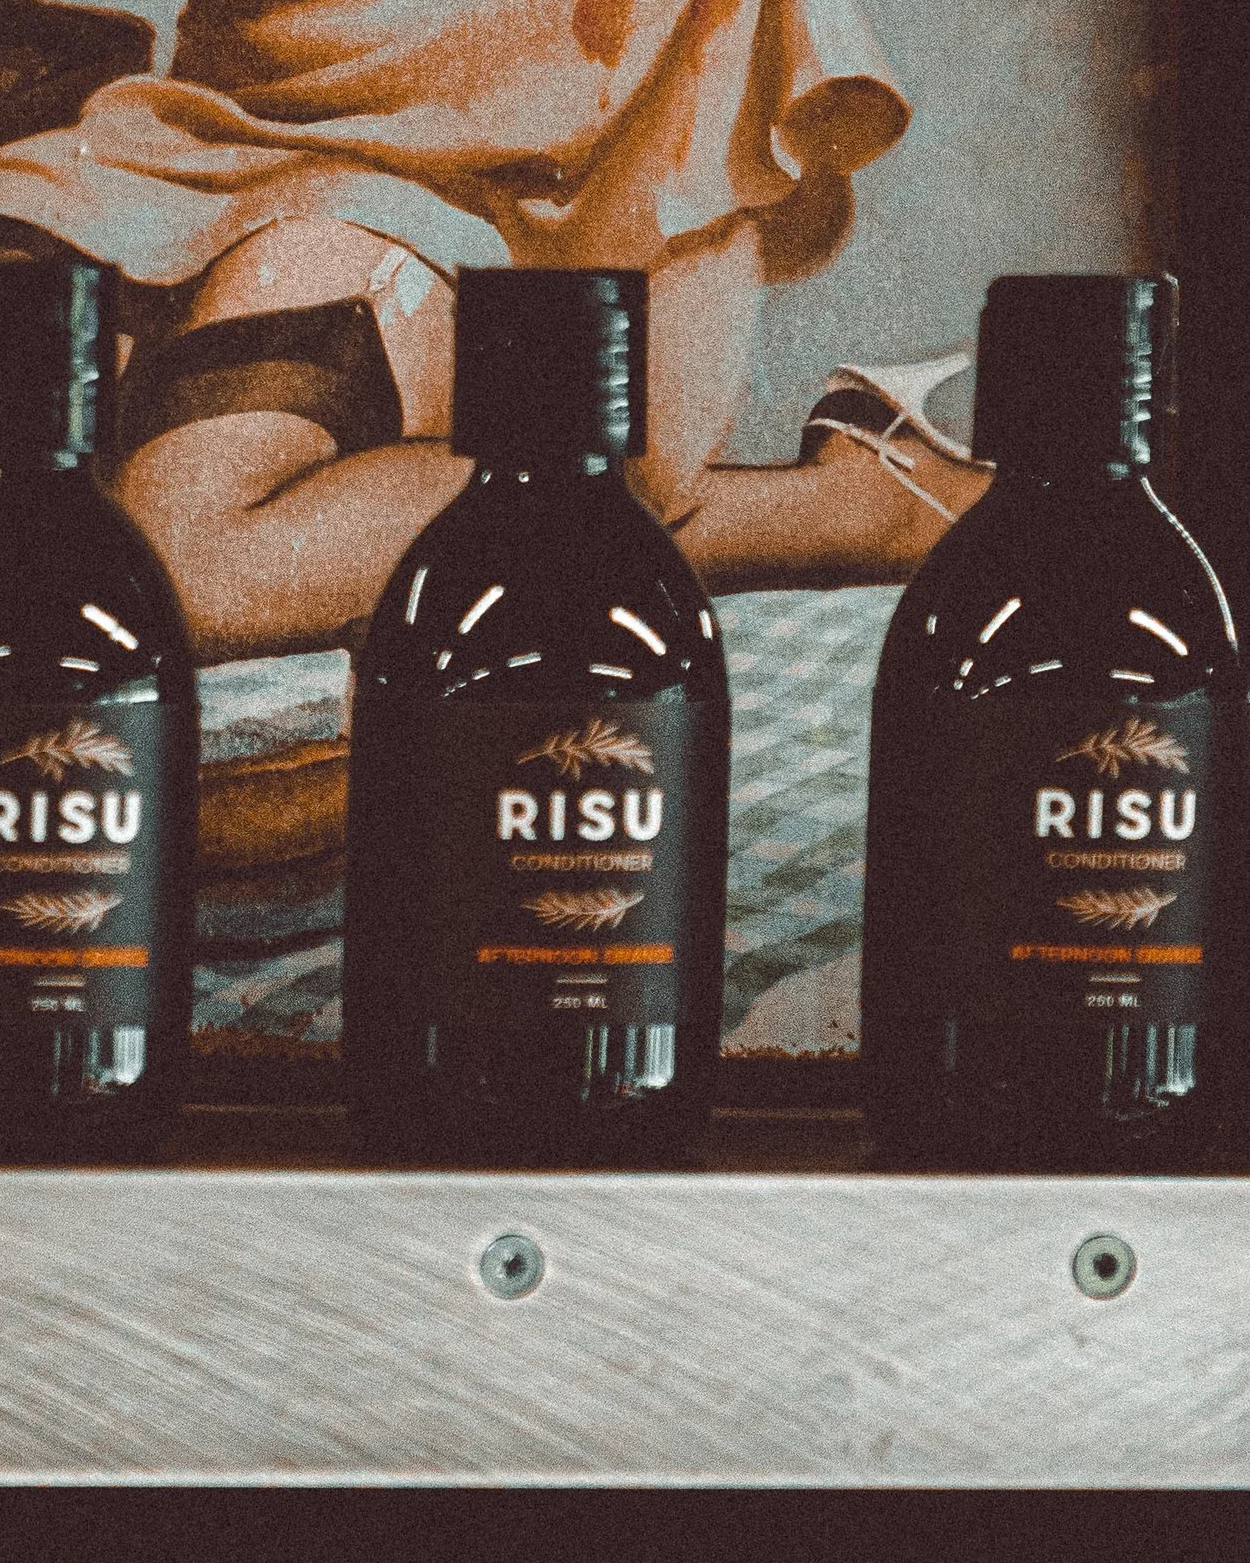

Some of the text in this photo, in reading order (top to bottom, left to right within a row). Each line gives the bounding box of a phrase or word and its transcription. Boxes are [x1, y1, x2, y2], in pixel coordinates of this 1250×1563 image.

[498, 789, 664, 841] RISU
[1036, 789, 1197, 840] RISU
[510, 851, 653, 872] CONDITIONER
[1046, 850, 1187, 871] CONDITIONER
